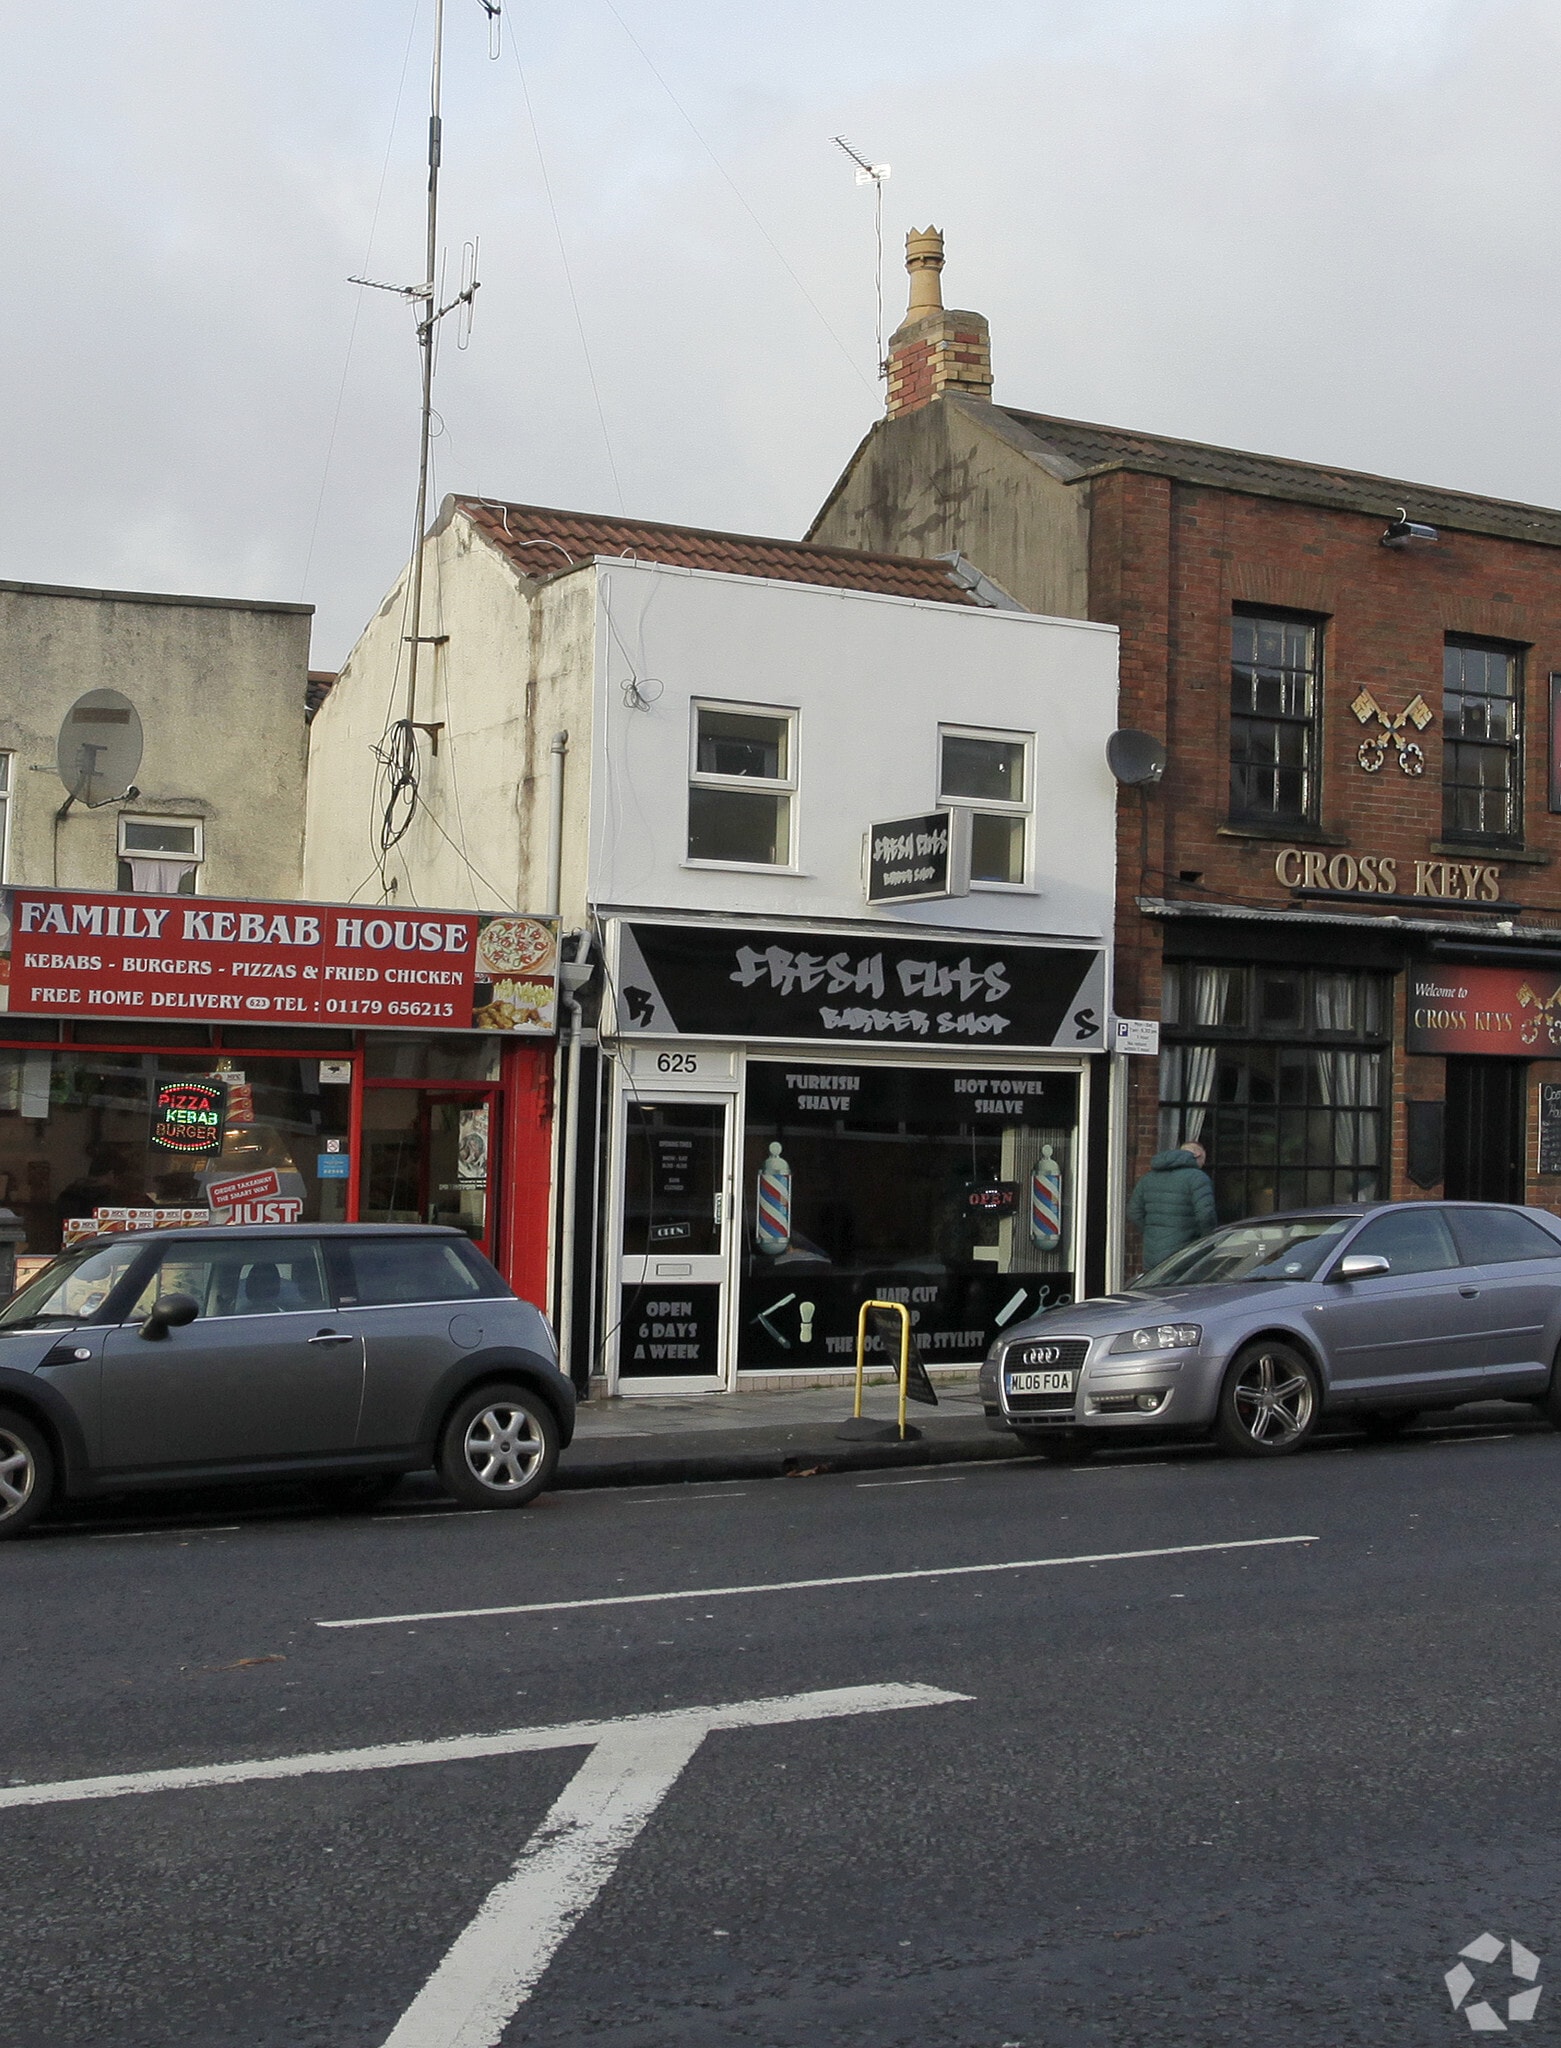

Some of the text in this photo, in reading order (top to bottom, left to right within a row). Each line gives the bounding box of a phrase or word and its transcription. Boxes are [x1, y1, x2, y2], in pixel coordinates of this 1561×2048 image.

[1276, 848, 1500, 902] CROSS KEYS
[19, 902, 469, 953] FAMILY KEBAB HOUSE
[24, 953, 102, 971] KEBABS
[122, 957, 213, 975] BURGERS
[232, 962, 297, 979] PIZZAS
[303, 966, 318, 980] &
[325, 966, 379, 982] FRIED
[385, 969, 464, 986] CHICKEN
[729, 945, 886, 1000] FRESH
[1415, 983, 1468, 998] Welcome to
[31, 988, 81, 1004] FREE
[88, 990, 144, 1006] HOME
[151, 993, 243, 1009] DELIVERY
[274, 997, 308, 1012] TEL
[326, 999, 382, 1015] 01179
[388, 1001, 454, 1017] 656213
[819, 1006, 1011, 1036] BARBER SHOP
[1073, 1008, 1100, 1040] S
[1414, 1008, 1512, 1031] CROSS KEYS
[657, 1053, 697, 1073] 625
[786, 1074, 860, 1090] TURKISH
[954, 1079, 1044, 1095] HOT TOWEL
[158, 1094, 210, 1111] PIZZA
[798, 1095, 850, 1110] SHAVE
[974, 1099, 1024, 1114] SHAVE
[165, 1109, 218, 1125] KEBAB
[156, 1123, 217, 1140] BURGER
[232, 1202, 297, 1224] JUST
[876, 1286, 938, 1303] HAIR CUT
[646, 1301, 692, 1317] OPEN
[639, 1321, 697, 1338] 6 DAYS
[826, 1336, 853, 1353] THE
[933, 1331, 985, 1348] STYLIST
[633, 1344, 700, 1359] A WEEK
[1012, 1374, 1068, 1390] ML06 FOA
